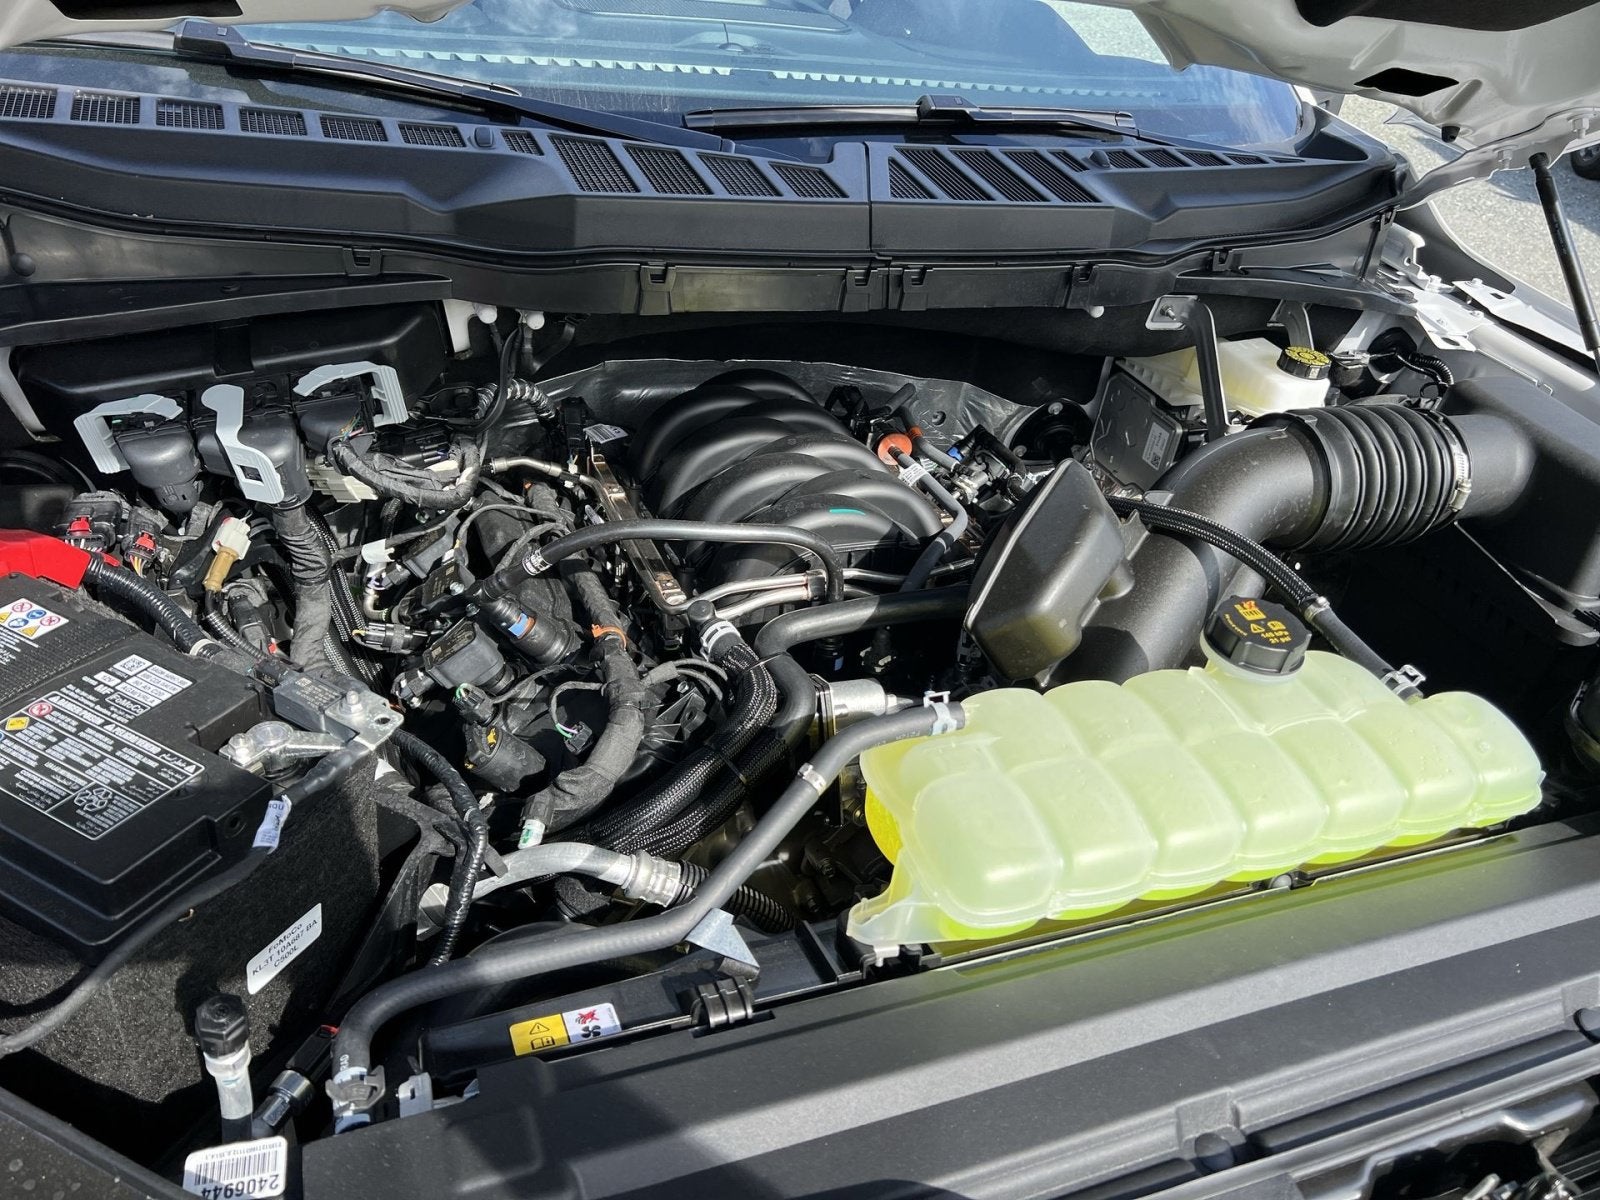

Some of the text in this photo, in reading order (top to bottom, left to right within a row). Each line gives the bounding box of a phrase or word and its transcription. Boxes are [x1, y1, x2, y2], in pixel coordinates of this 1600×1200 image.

[106, 694, 145, 715] FoMoCo
[268, 923, 302, 954] FoMoCo
[252, 953, 274, 976] KL3T
[201, 1174, 279, 1200] 2406944
